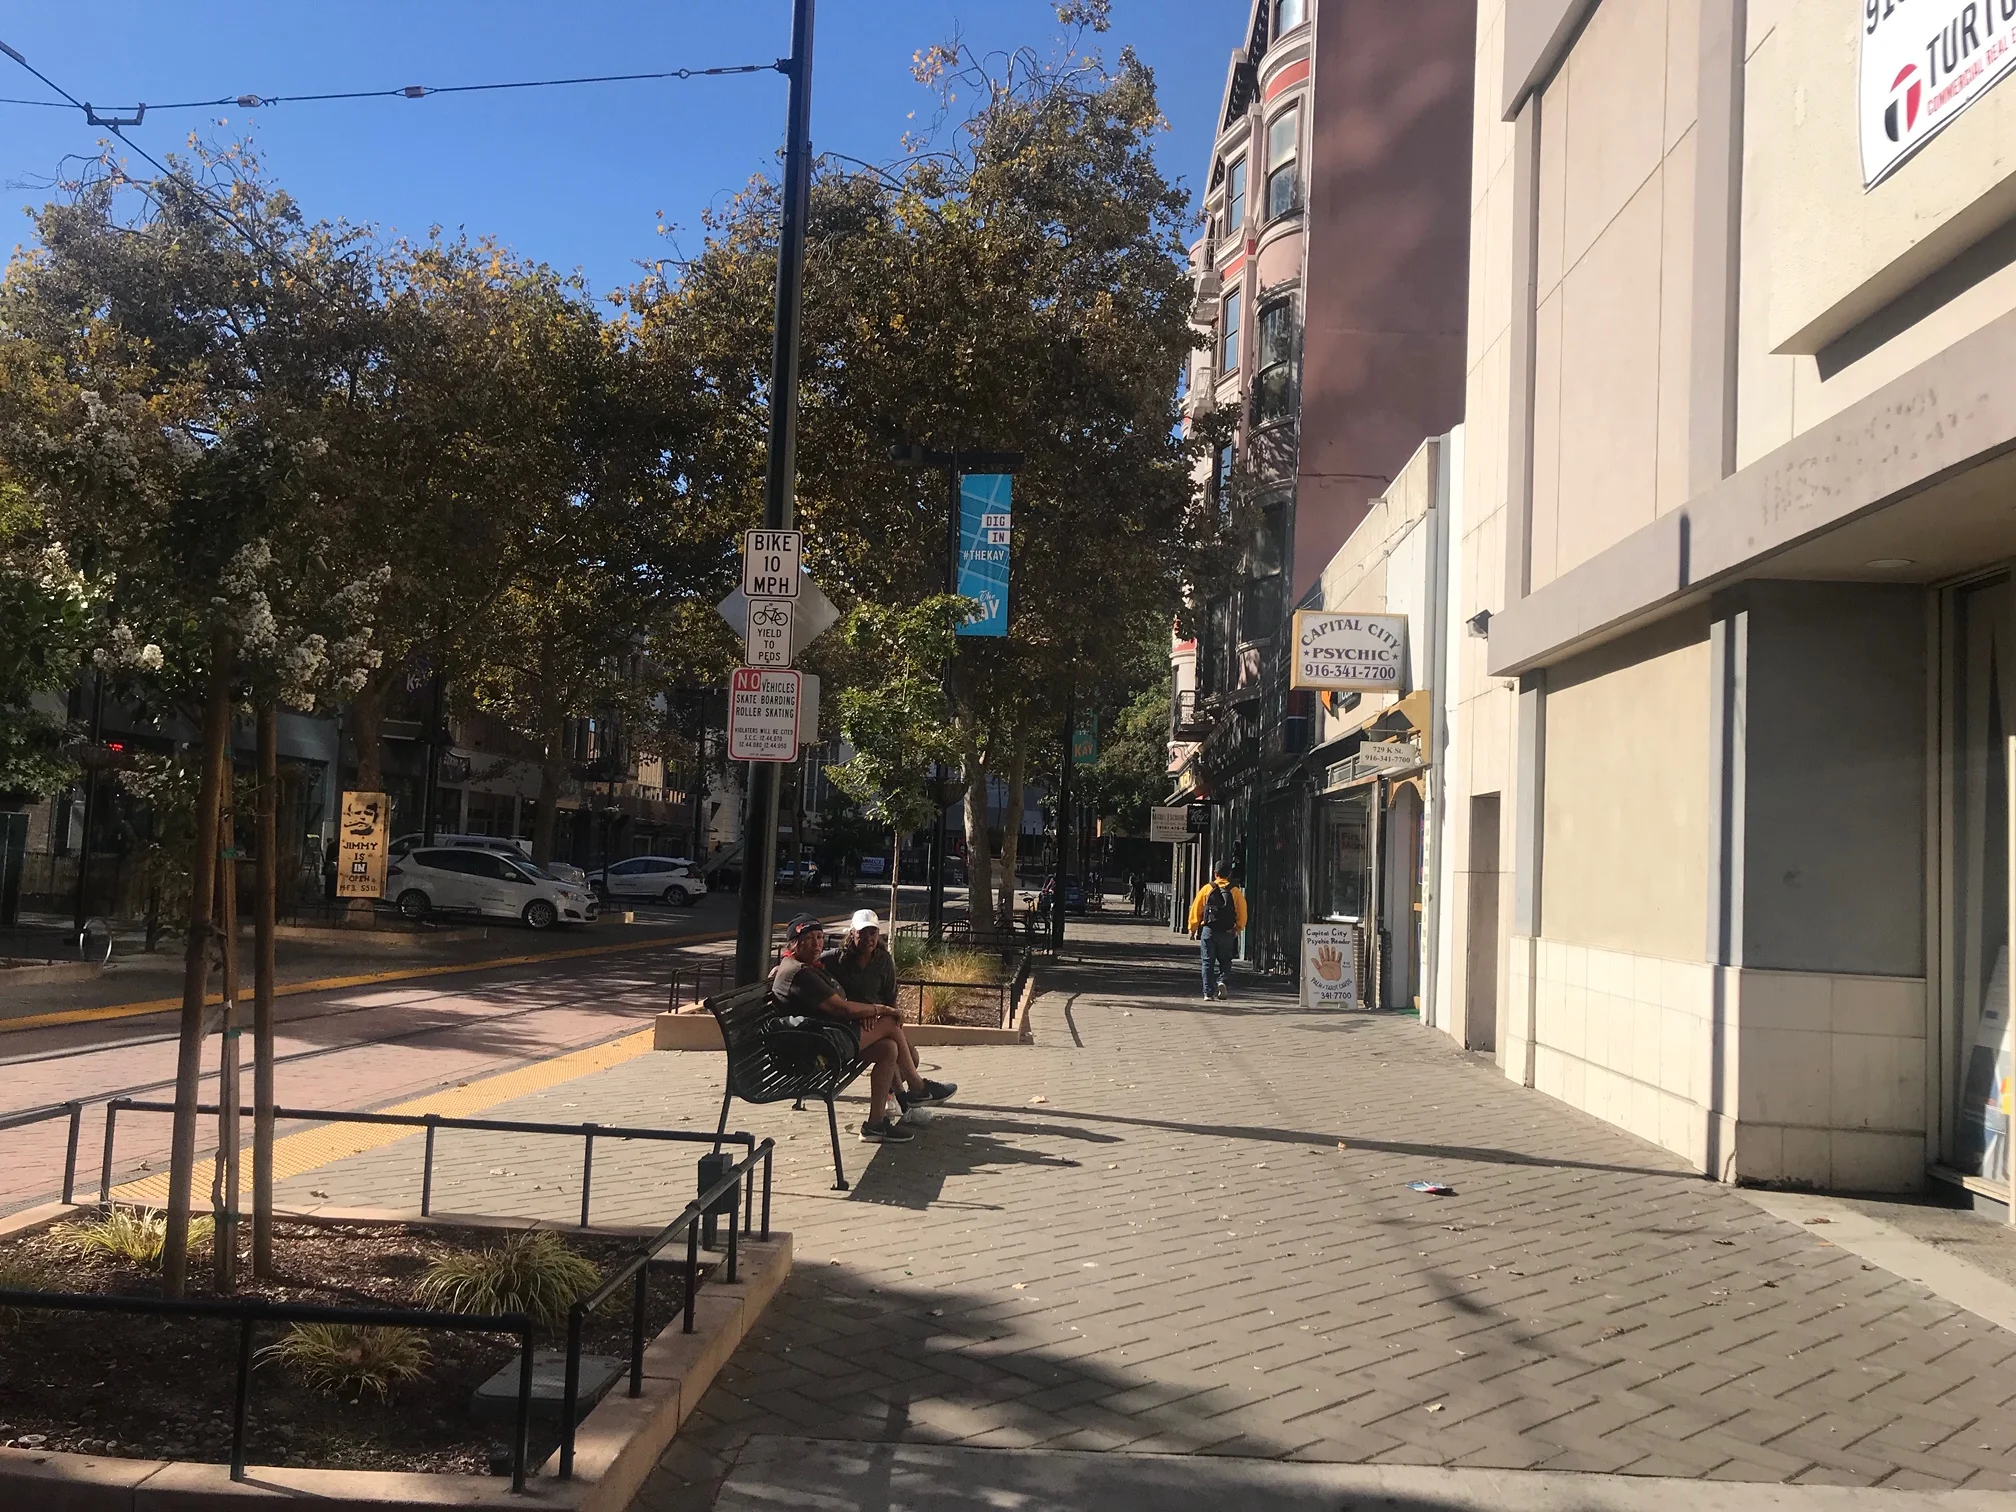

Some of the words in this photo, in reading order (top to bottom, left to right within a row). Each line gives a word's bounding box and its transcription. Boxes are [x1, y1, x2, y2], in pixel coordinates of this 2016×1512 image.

[986, 515, 1005, 527] DIG
[755, 534, 792, 552] BIKE
[992, 531, 1005, 543] IN
[963, 549, 1005, 561] #THEKAY
[764, 555, 781, 573] 10
[754, 576, 789, 594] MPH
[757, 628, 782, 638] YIELD
[1300, 619, 1362, 647] CAPITAL
[1367, 623, 1402, 650] CITY
[764, 639, 775, 650] TO
[758, 651, 781, 661] PEDS
[1312, 647, 1390, 662] PSYCHIC
[1305, 664, 1396, 680] 916-341-7700
[737, 672, 760, 690] NO
[762, 681, 795, 693] VEHICLES
[736, 694, 757, 704] SKATE
[760, 695, 795, 705] BOARDING
[736, 706, 761, 717] ROLLER
[765, 708, 794, 718] SKATING
[1074, 742, 1093, 757] KAY
[1365, 754, 1411, 764] 916-341-7700
[343, 842, 378, 850] JIMMY
[354, 852, 365, 861] IS
[353, 863, 366, 872] IN
[1306, 928, 1330, 938] Capital
[1331, 927, 1347, 938] City
[1306, 937, 1330, 946] Psychic
[1331, 937, 1351, 945] Reader
[1320, 991, 1352, 999] 341-7700
